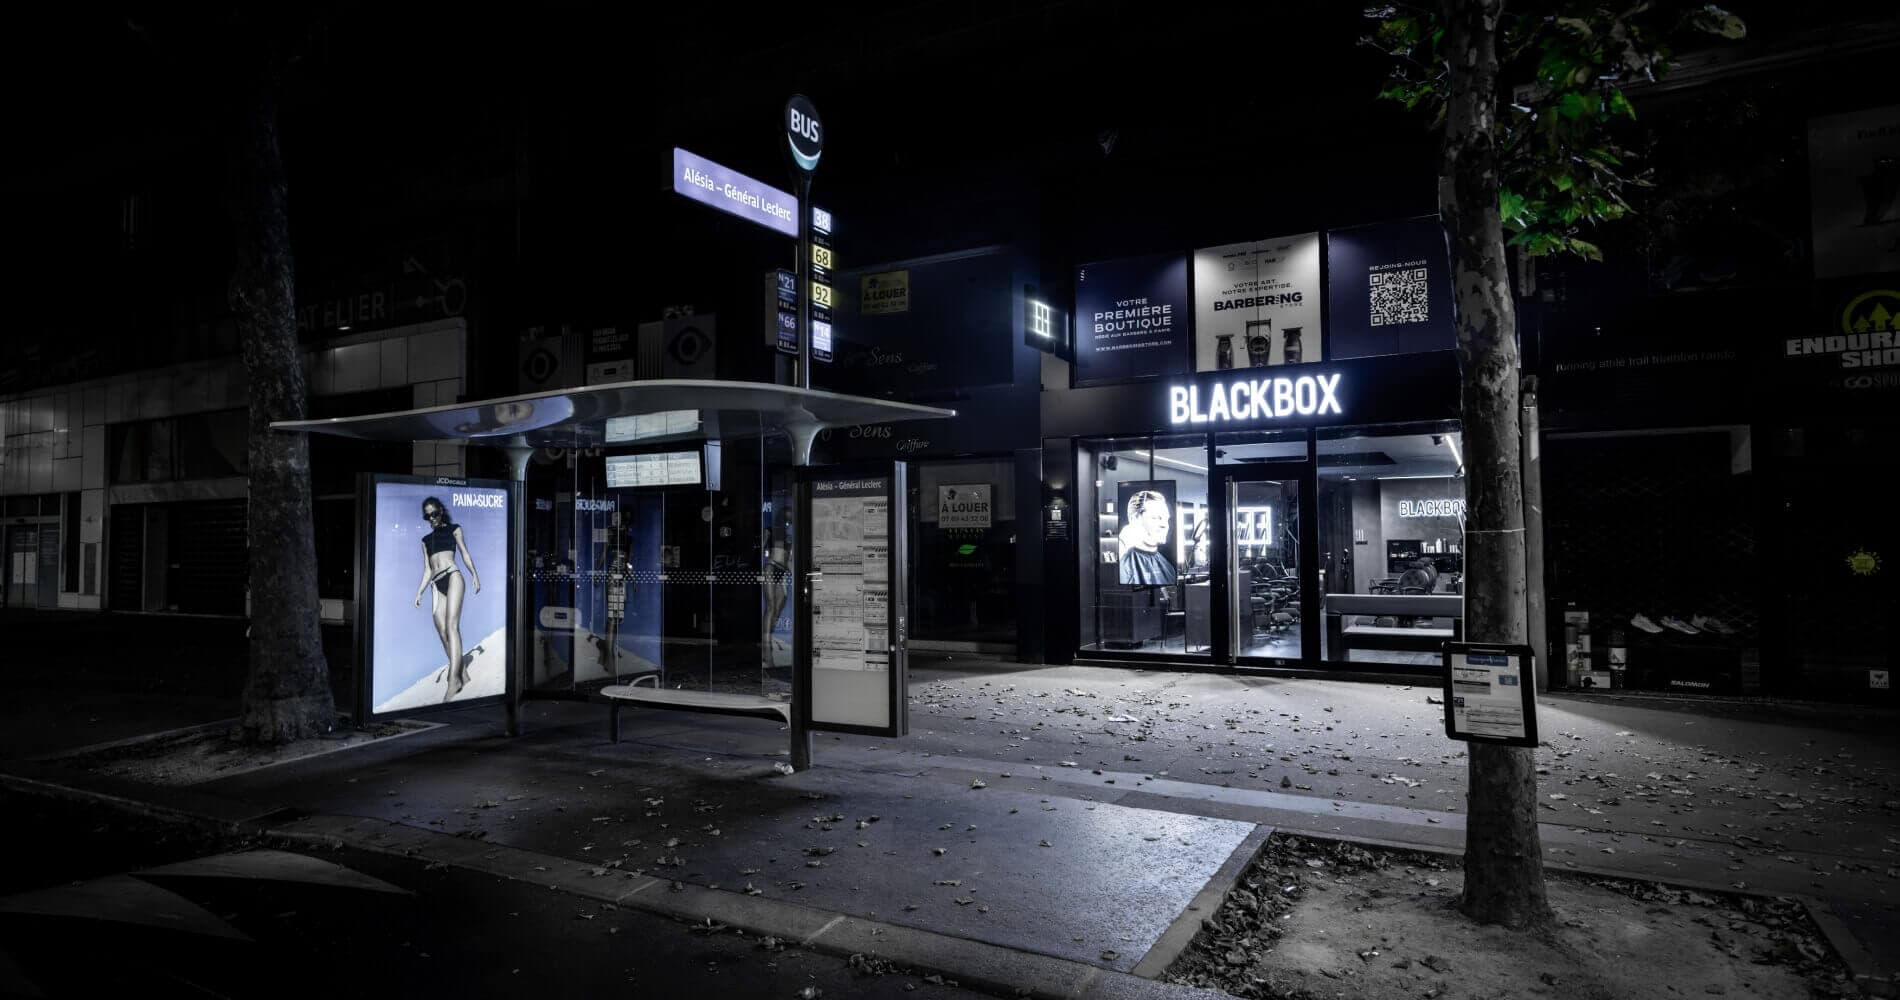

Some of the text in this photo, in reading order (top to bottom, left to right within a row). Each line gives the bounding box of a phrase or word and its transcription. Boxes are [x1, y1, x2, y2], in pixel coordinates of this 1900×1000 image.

[790, 108, 819, 143] BUS
[684, 167, 714, 192] Alésia
[724, 183, 760, 209] Général
[762, 198, 791, 222] Leclerc
[816, 211, 828, 229] 38
[815, 249, 829, 266] 68
[1369, 259, 1427, 271] REJOINS-NOUS
[778, 272, 794, 290] N21
[1233, 281, 1258, 289] VOTRE
[815, 286, 829, 303] 92
[873, 288, 906, 301] LOUER
[1116, 298, 1148, 308] VOTRE
[297, 290, 384, 333] ATELIER
[1094, 304, 1172, 322] PREMIÈRE
[778, 312, 796, 329] N66
[1094, 316, 1172, 333] BOUTIQUE
[1170, 373, 1342, 424] BLACKBOX
[816, 482, 833, 491] Alésia
[839, 480, 861, 490] Général
[862, 480, 882, 489] Leclerc
[952, 502, 989, 513] LOUER
